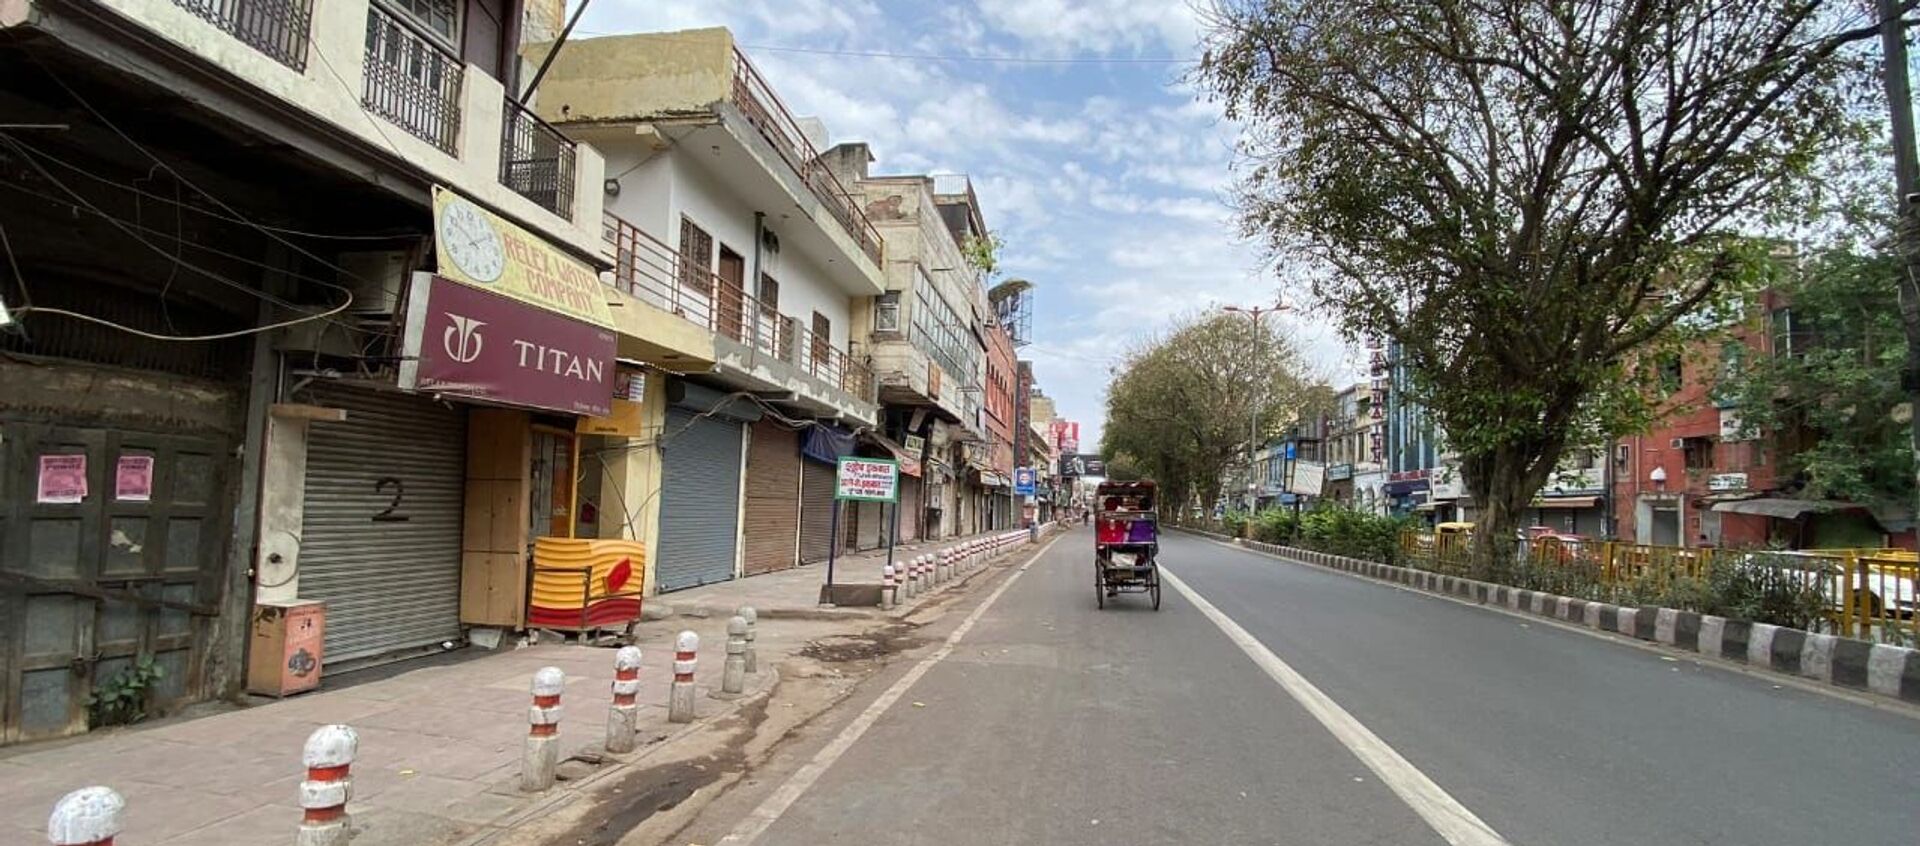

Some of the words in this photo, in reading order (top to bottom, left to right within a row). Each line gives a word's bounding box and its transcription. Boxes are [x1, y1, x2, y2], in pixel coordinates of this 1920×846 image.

[526, 269, 594, 314] COMPANY
[513, 340, 603, 383] TITAN
[371, 476, 409, 521] 2
